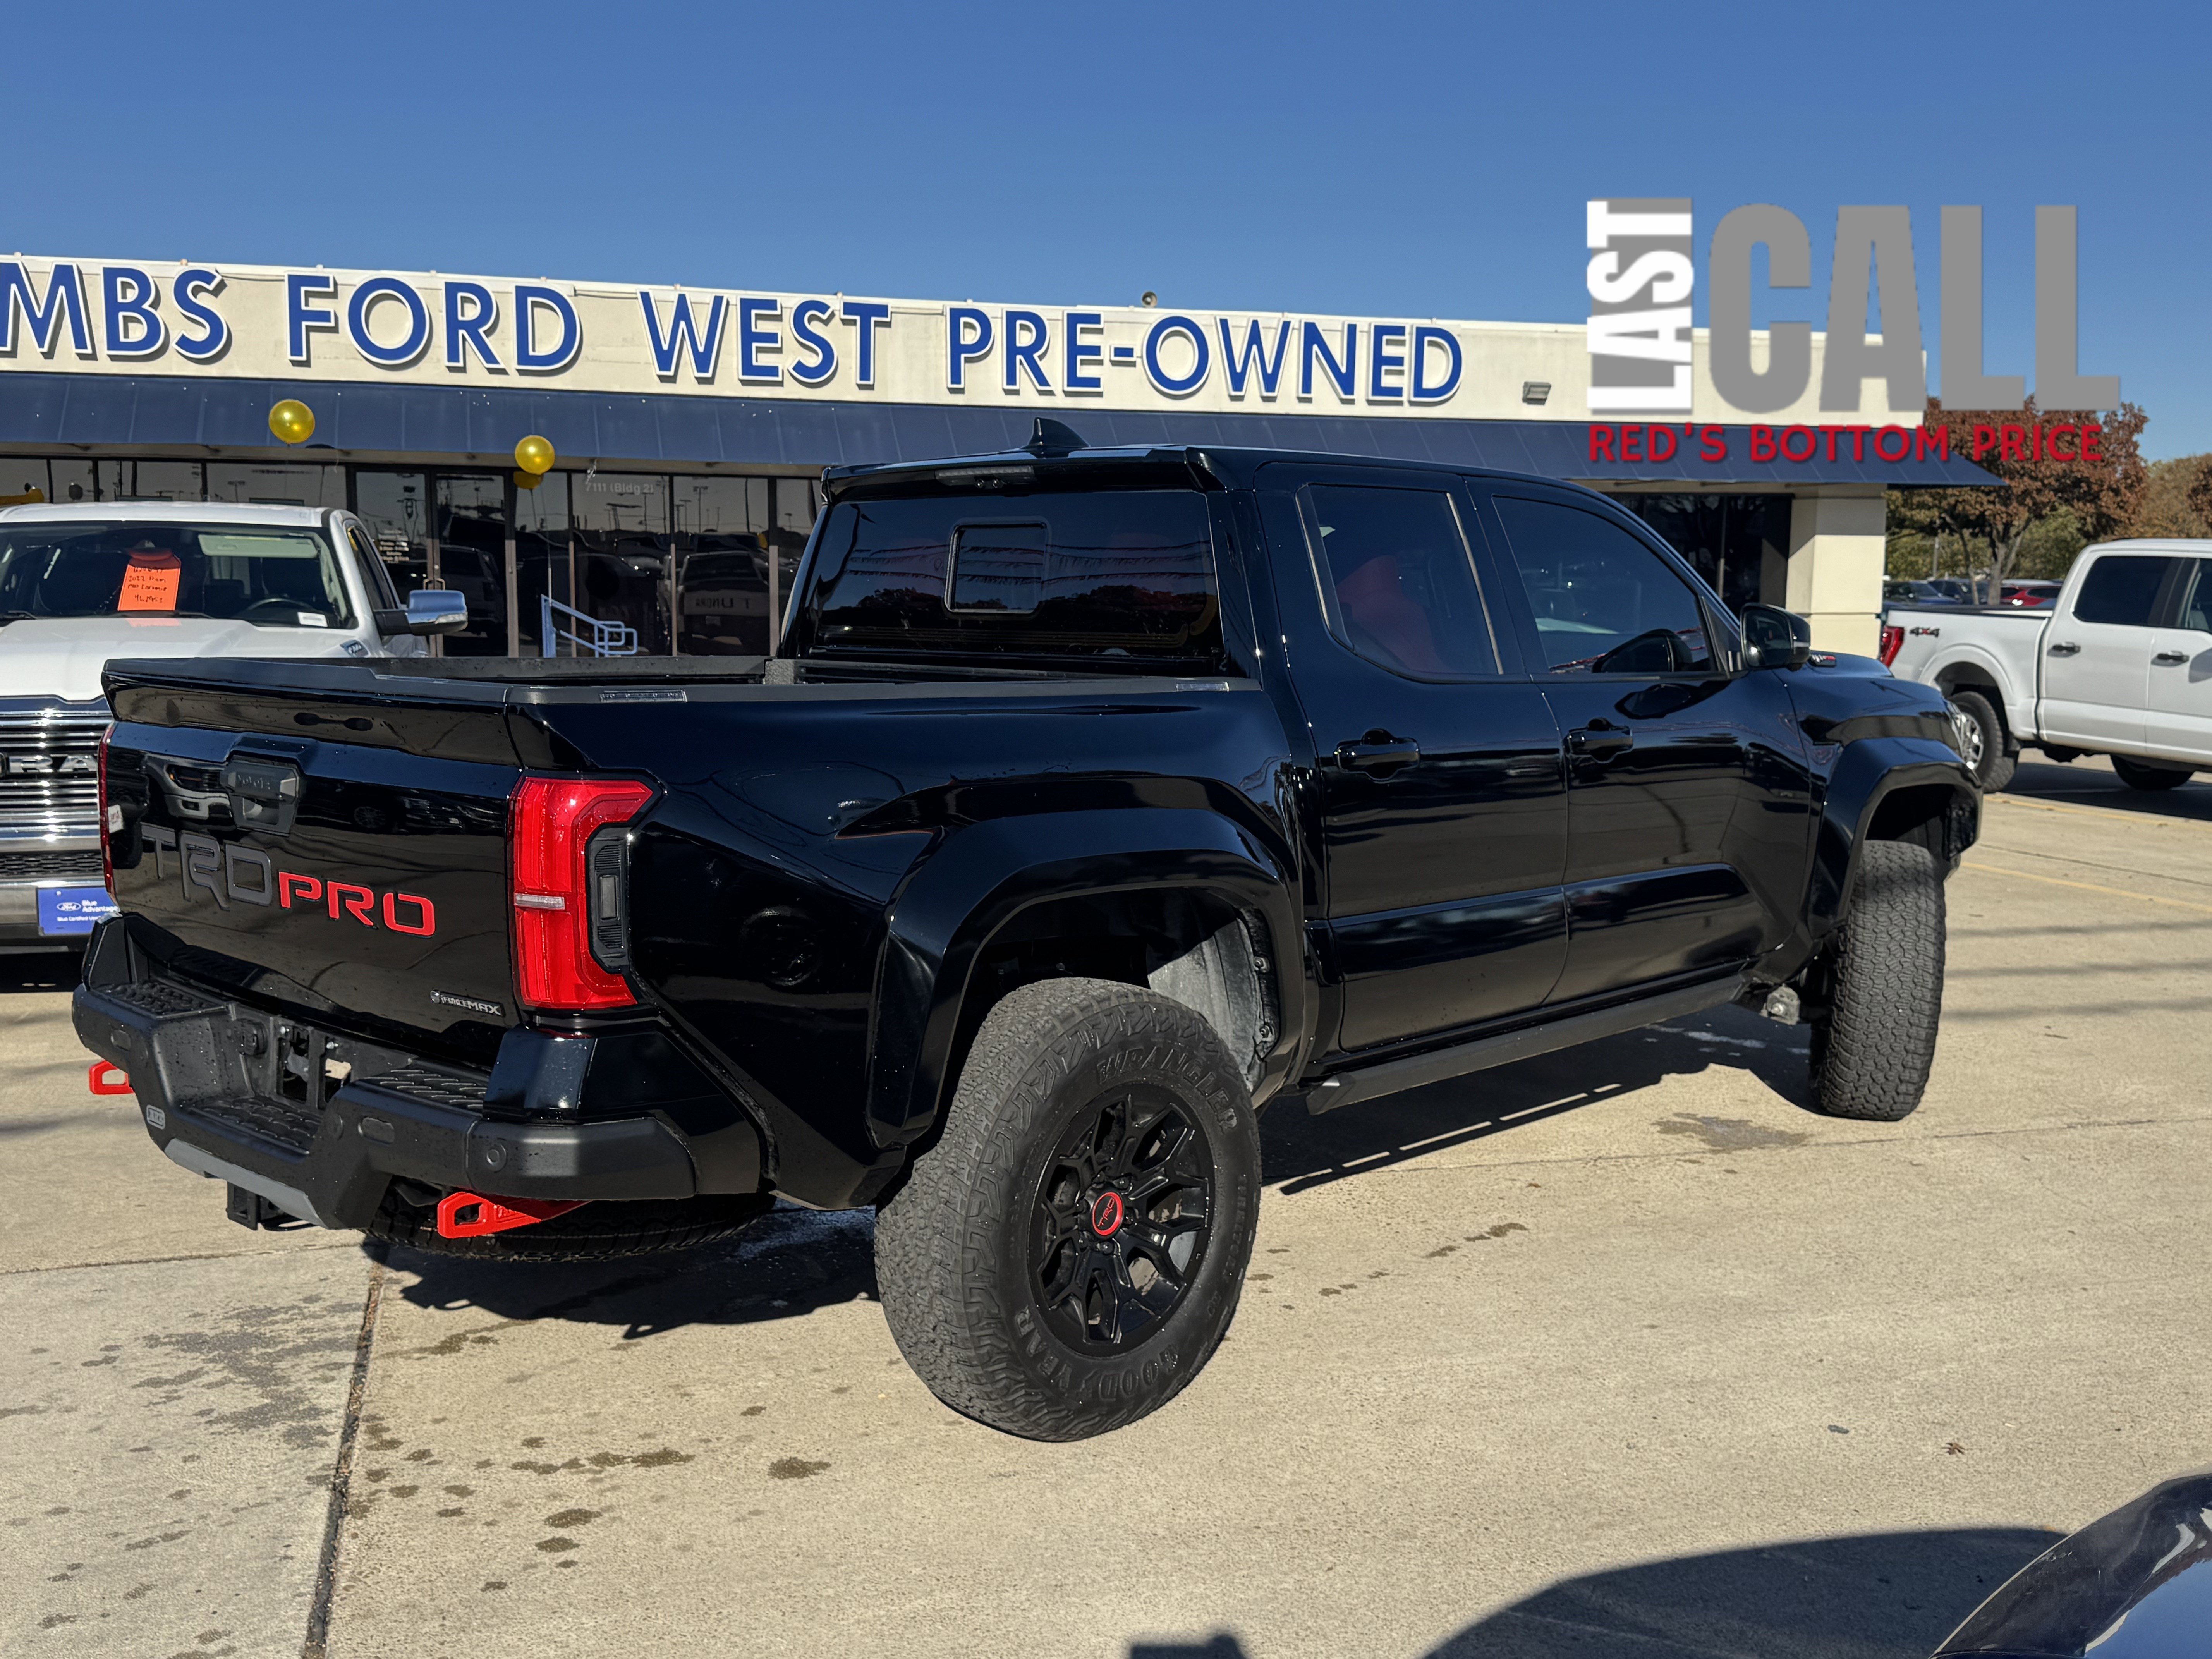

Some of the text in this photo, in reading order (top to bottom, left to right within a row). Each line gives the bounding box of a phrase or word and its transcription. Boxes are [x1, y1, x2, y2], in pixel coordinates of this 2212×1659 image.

[0, 260, 1465, 405] MBS FORD WEST PRE-OWNED
[9, 755, 98, 773] RA
[141, 821, 436, 936] TRD PRO
[1097, 1045, 1238, 1135] WRANGLER
[1097, 1197, 1115, 1227] TRD
